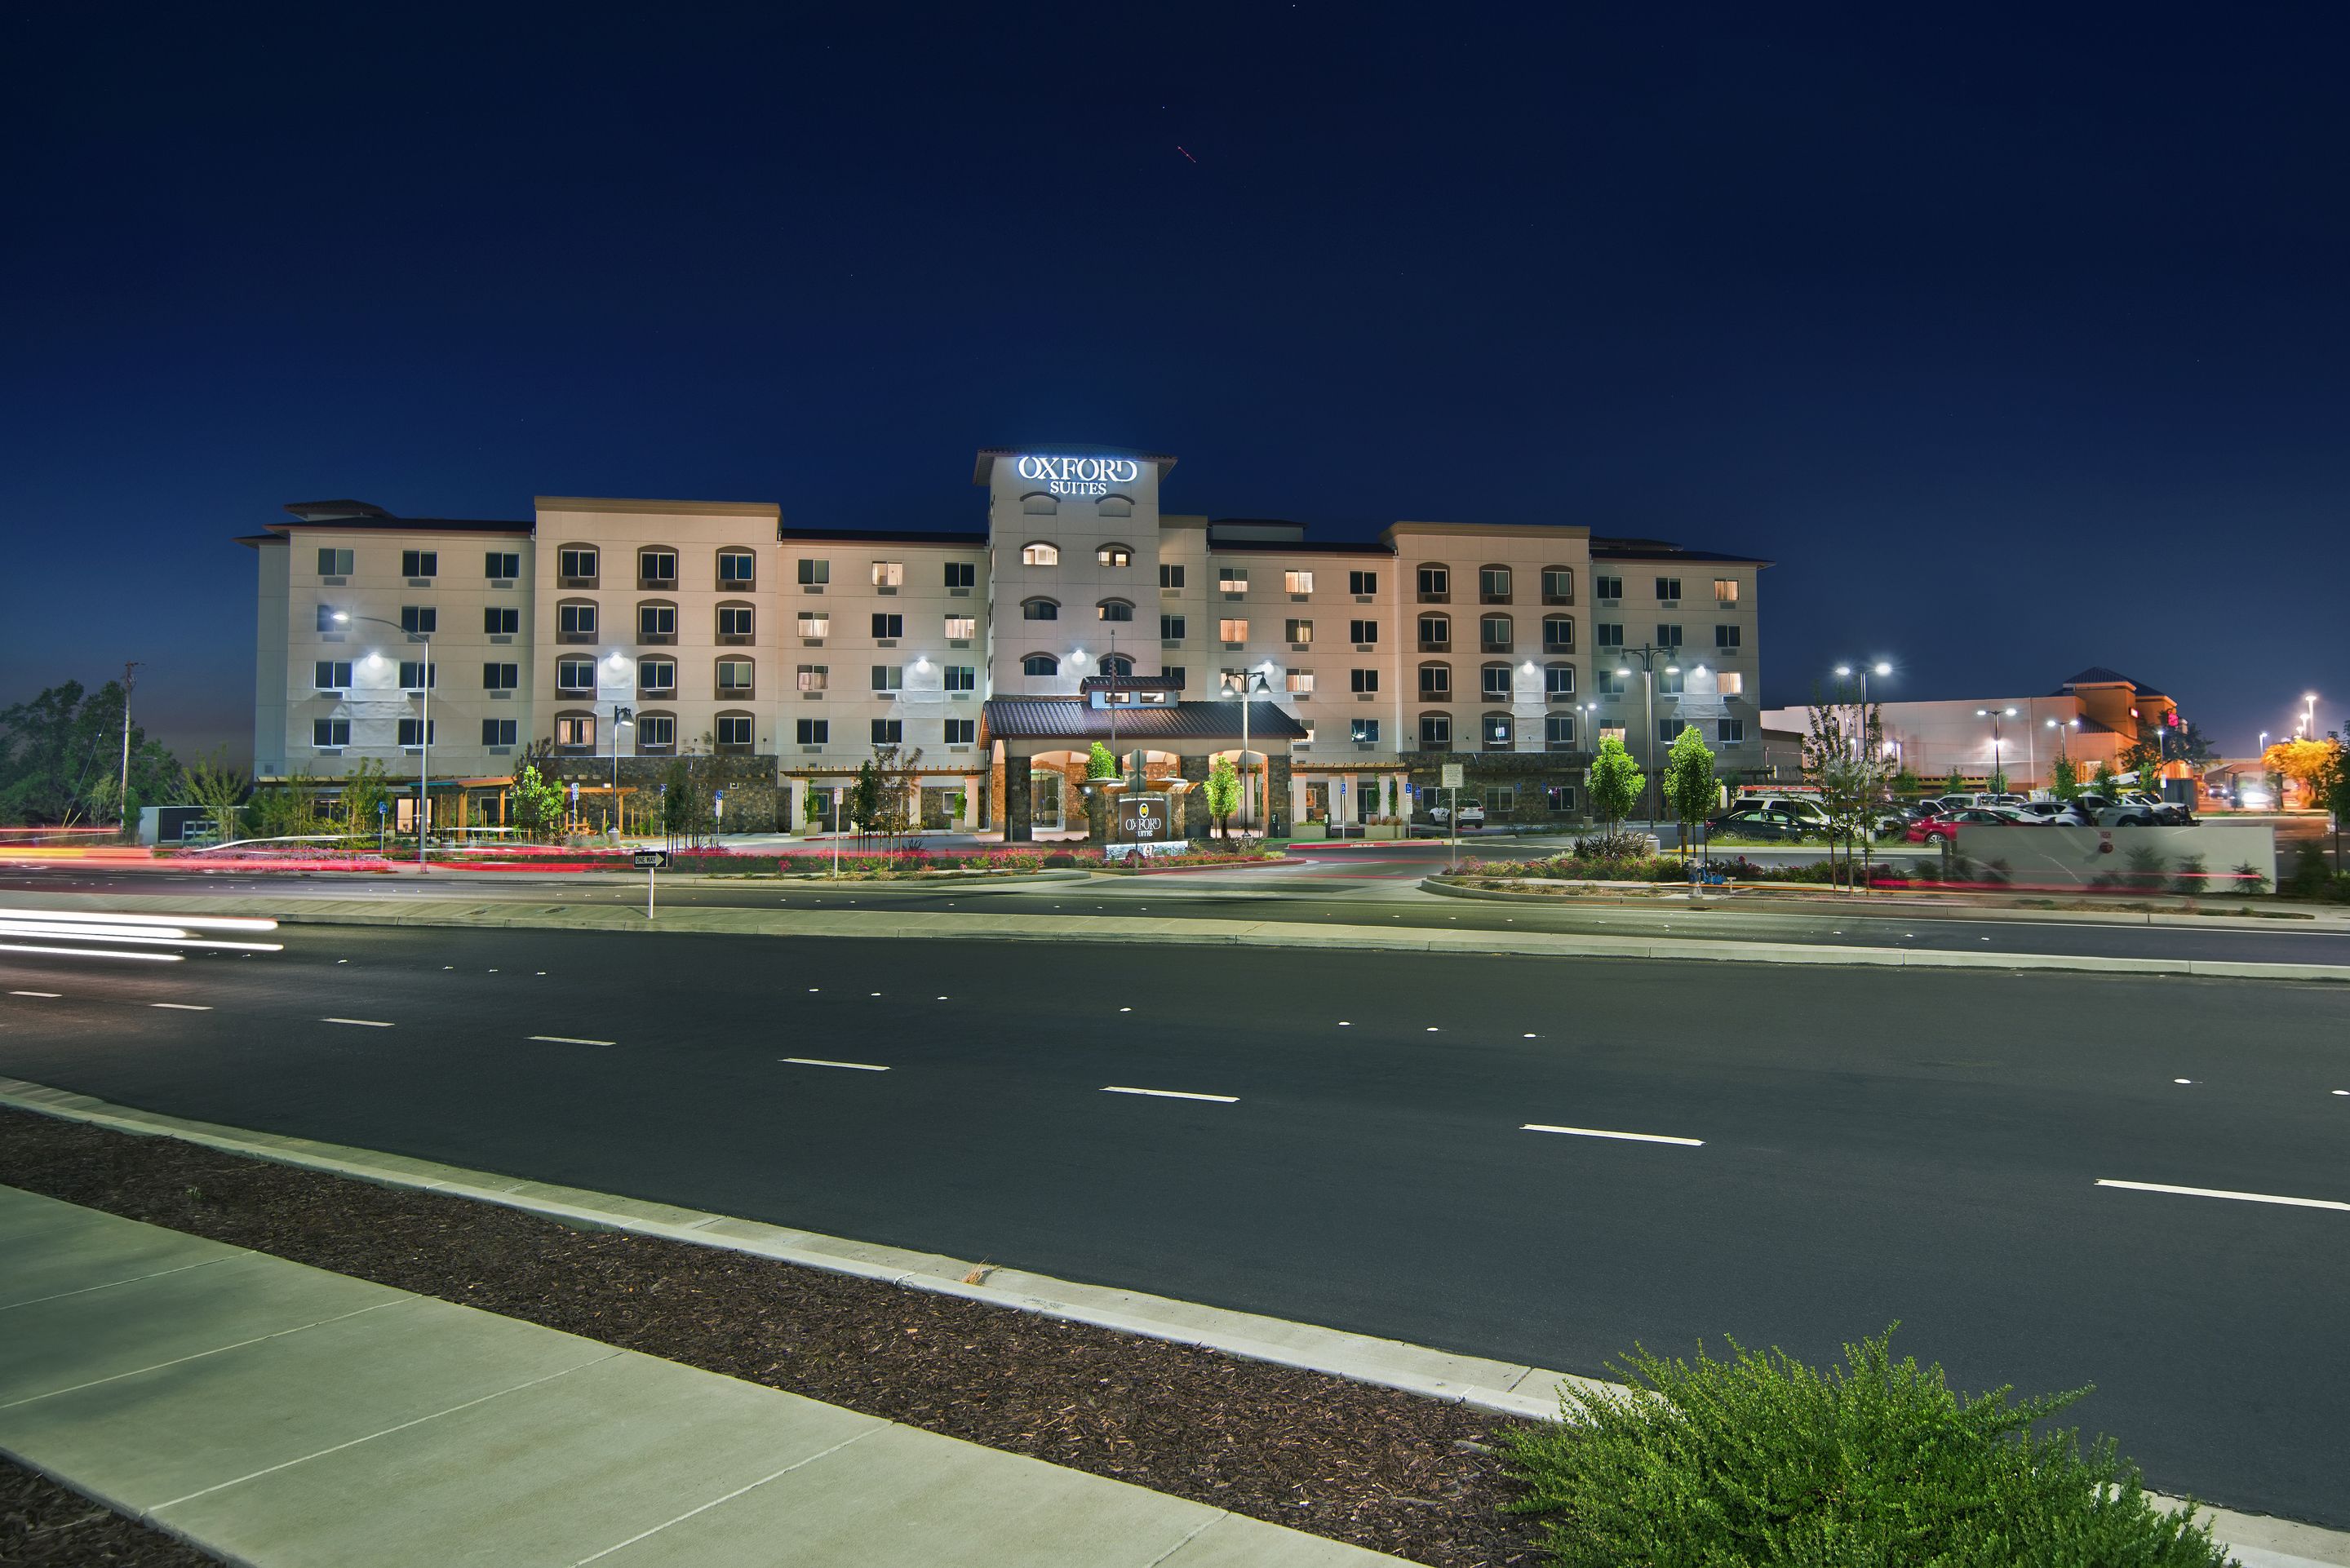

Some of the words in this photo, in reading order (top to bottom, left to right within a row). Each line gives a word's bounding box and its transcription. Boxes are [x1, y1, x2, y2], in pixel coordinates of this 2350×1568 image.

[1018, 456, 1137, 482] OXFORD
[1050, 481, 1107, 495] SUITES
[1125, 817, 1161, 831] OXFORD
